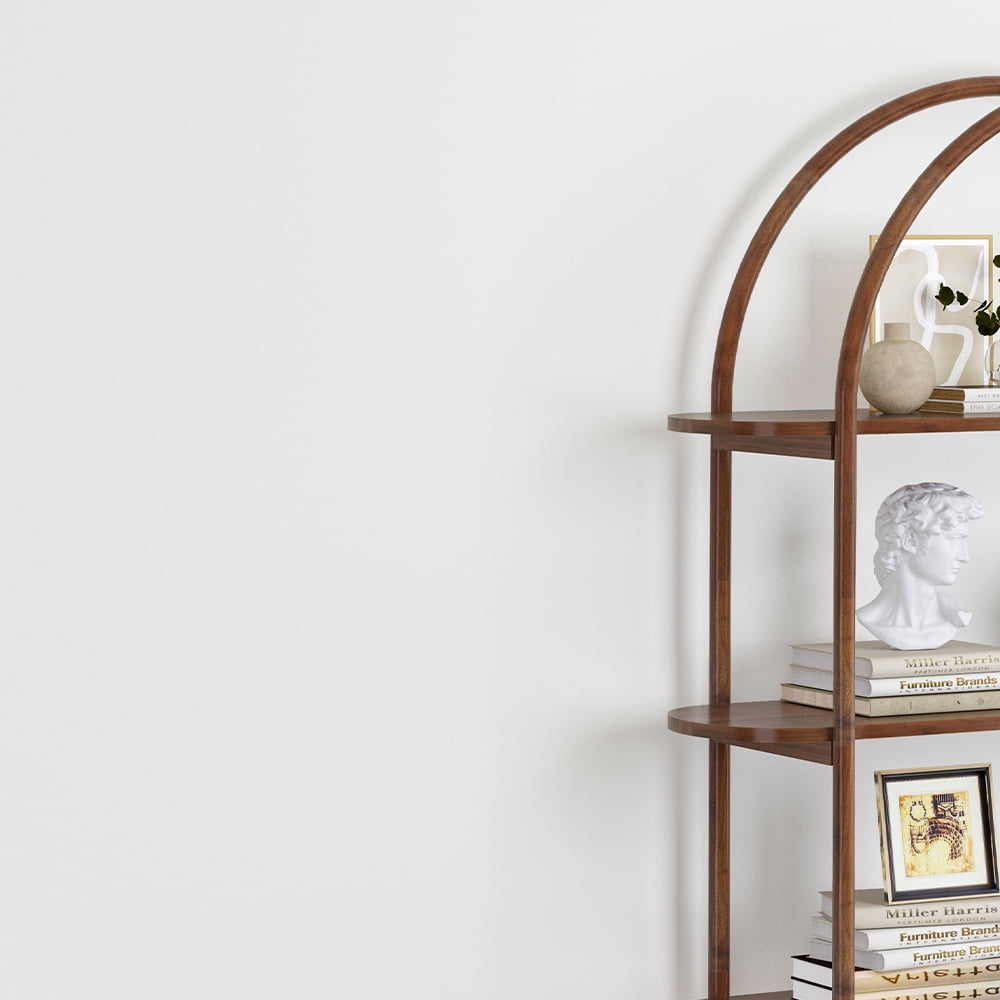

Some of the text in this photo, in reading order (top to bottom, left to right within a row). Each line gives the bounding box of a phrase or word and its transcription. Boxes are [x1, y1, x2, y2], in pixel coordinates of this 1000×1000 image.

[904, 654, 1000, 669] Miller Harris
[899, 675, 998, 690] Furniture Brands
[886, 904, 998, 919] Miller Harris
[900, 930, 958, 942] Furniture
[913, 949, 967, 962] Furniture
